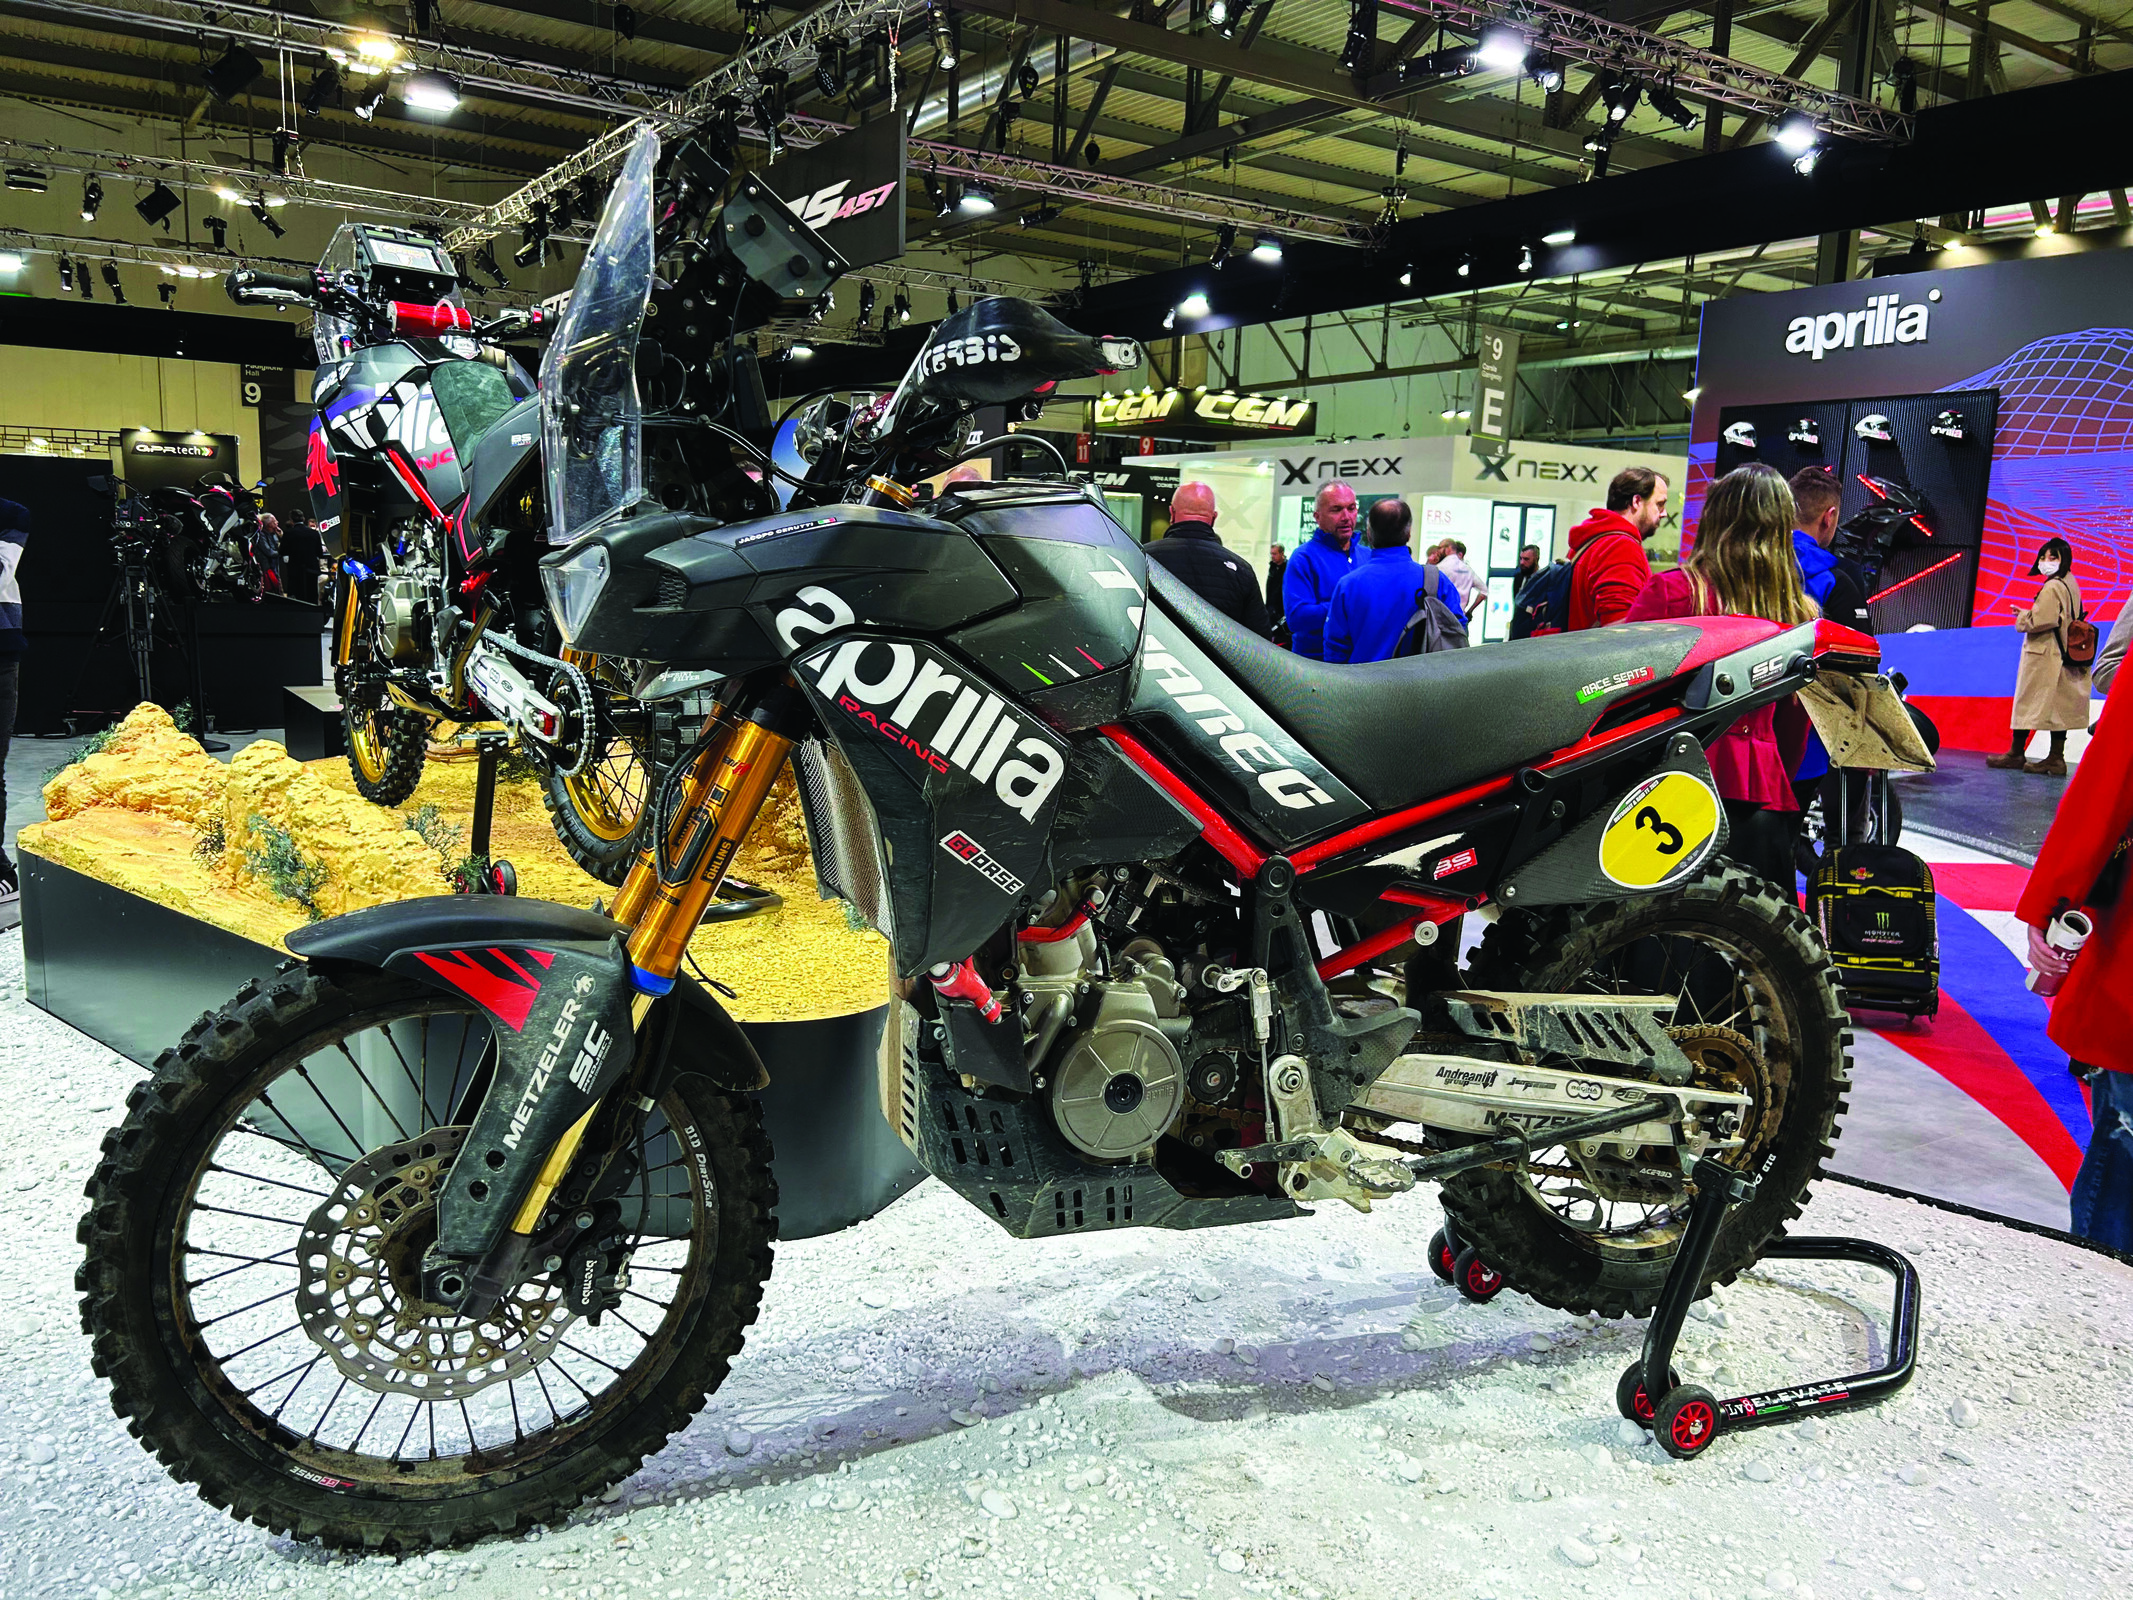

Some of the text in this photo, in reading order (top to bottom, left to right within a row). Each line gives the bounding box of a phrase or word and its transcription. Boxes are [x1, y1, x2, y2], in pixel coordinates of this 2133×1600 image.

[832, 182, 898, 219] 457
[1785, 293, 1930, 360] aprilia
[1492, 338, 1503, 360] 9
[244, 382, 262, 404] 9
[1095, 391, 1178, 423] CGM
[1194, 394, 1309, 427] CGM
[1481, 388, 1505, 436] E
[1078, 444, 1088, 461] 11
[1142, 437, 1150, 454] 9
[738, 522, 814, 544] JACOPO CERUTTI
[1582, 666, 1648, 696] RACE SEATS
[1752, 654, 1783, 679] SC
[775, 585, 1065, 824] aprilia
[838, 694, 951, 775] RACING
[1635, 805, 1684, 855] 3
[704, 841, 732, 880] ÖHLINS
[941, 832, 1024, 894] GCORSE
[568, 1019, 608, 1090] SC
[502, 998, 583, 1150] METZELER
[1435, 1066, 1488, 1084] Andreani
[581, 1258, 598, 1306] brembo
[1751, 1381, 1849, 1408] ELEVATE
